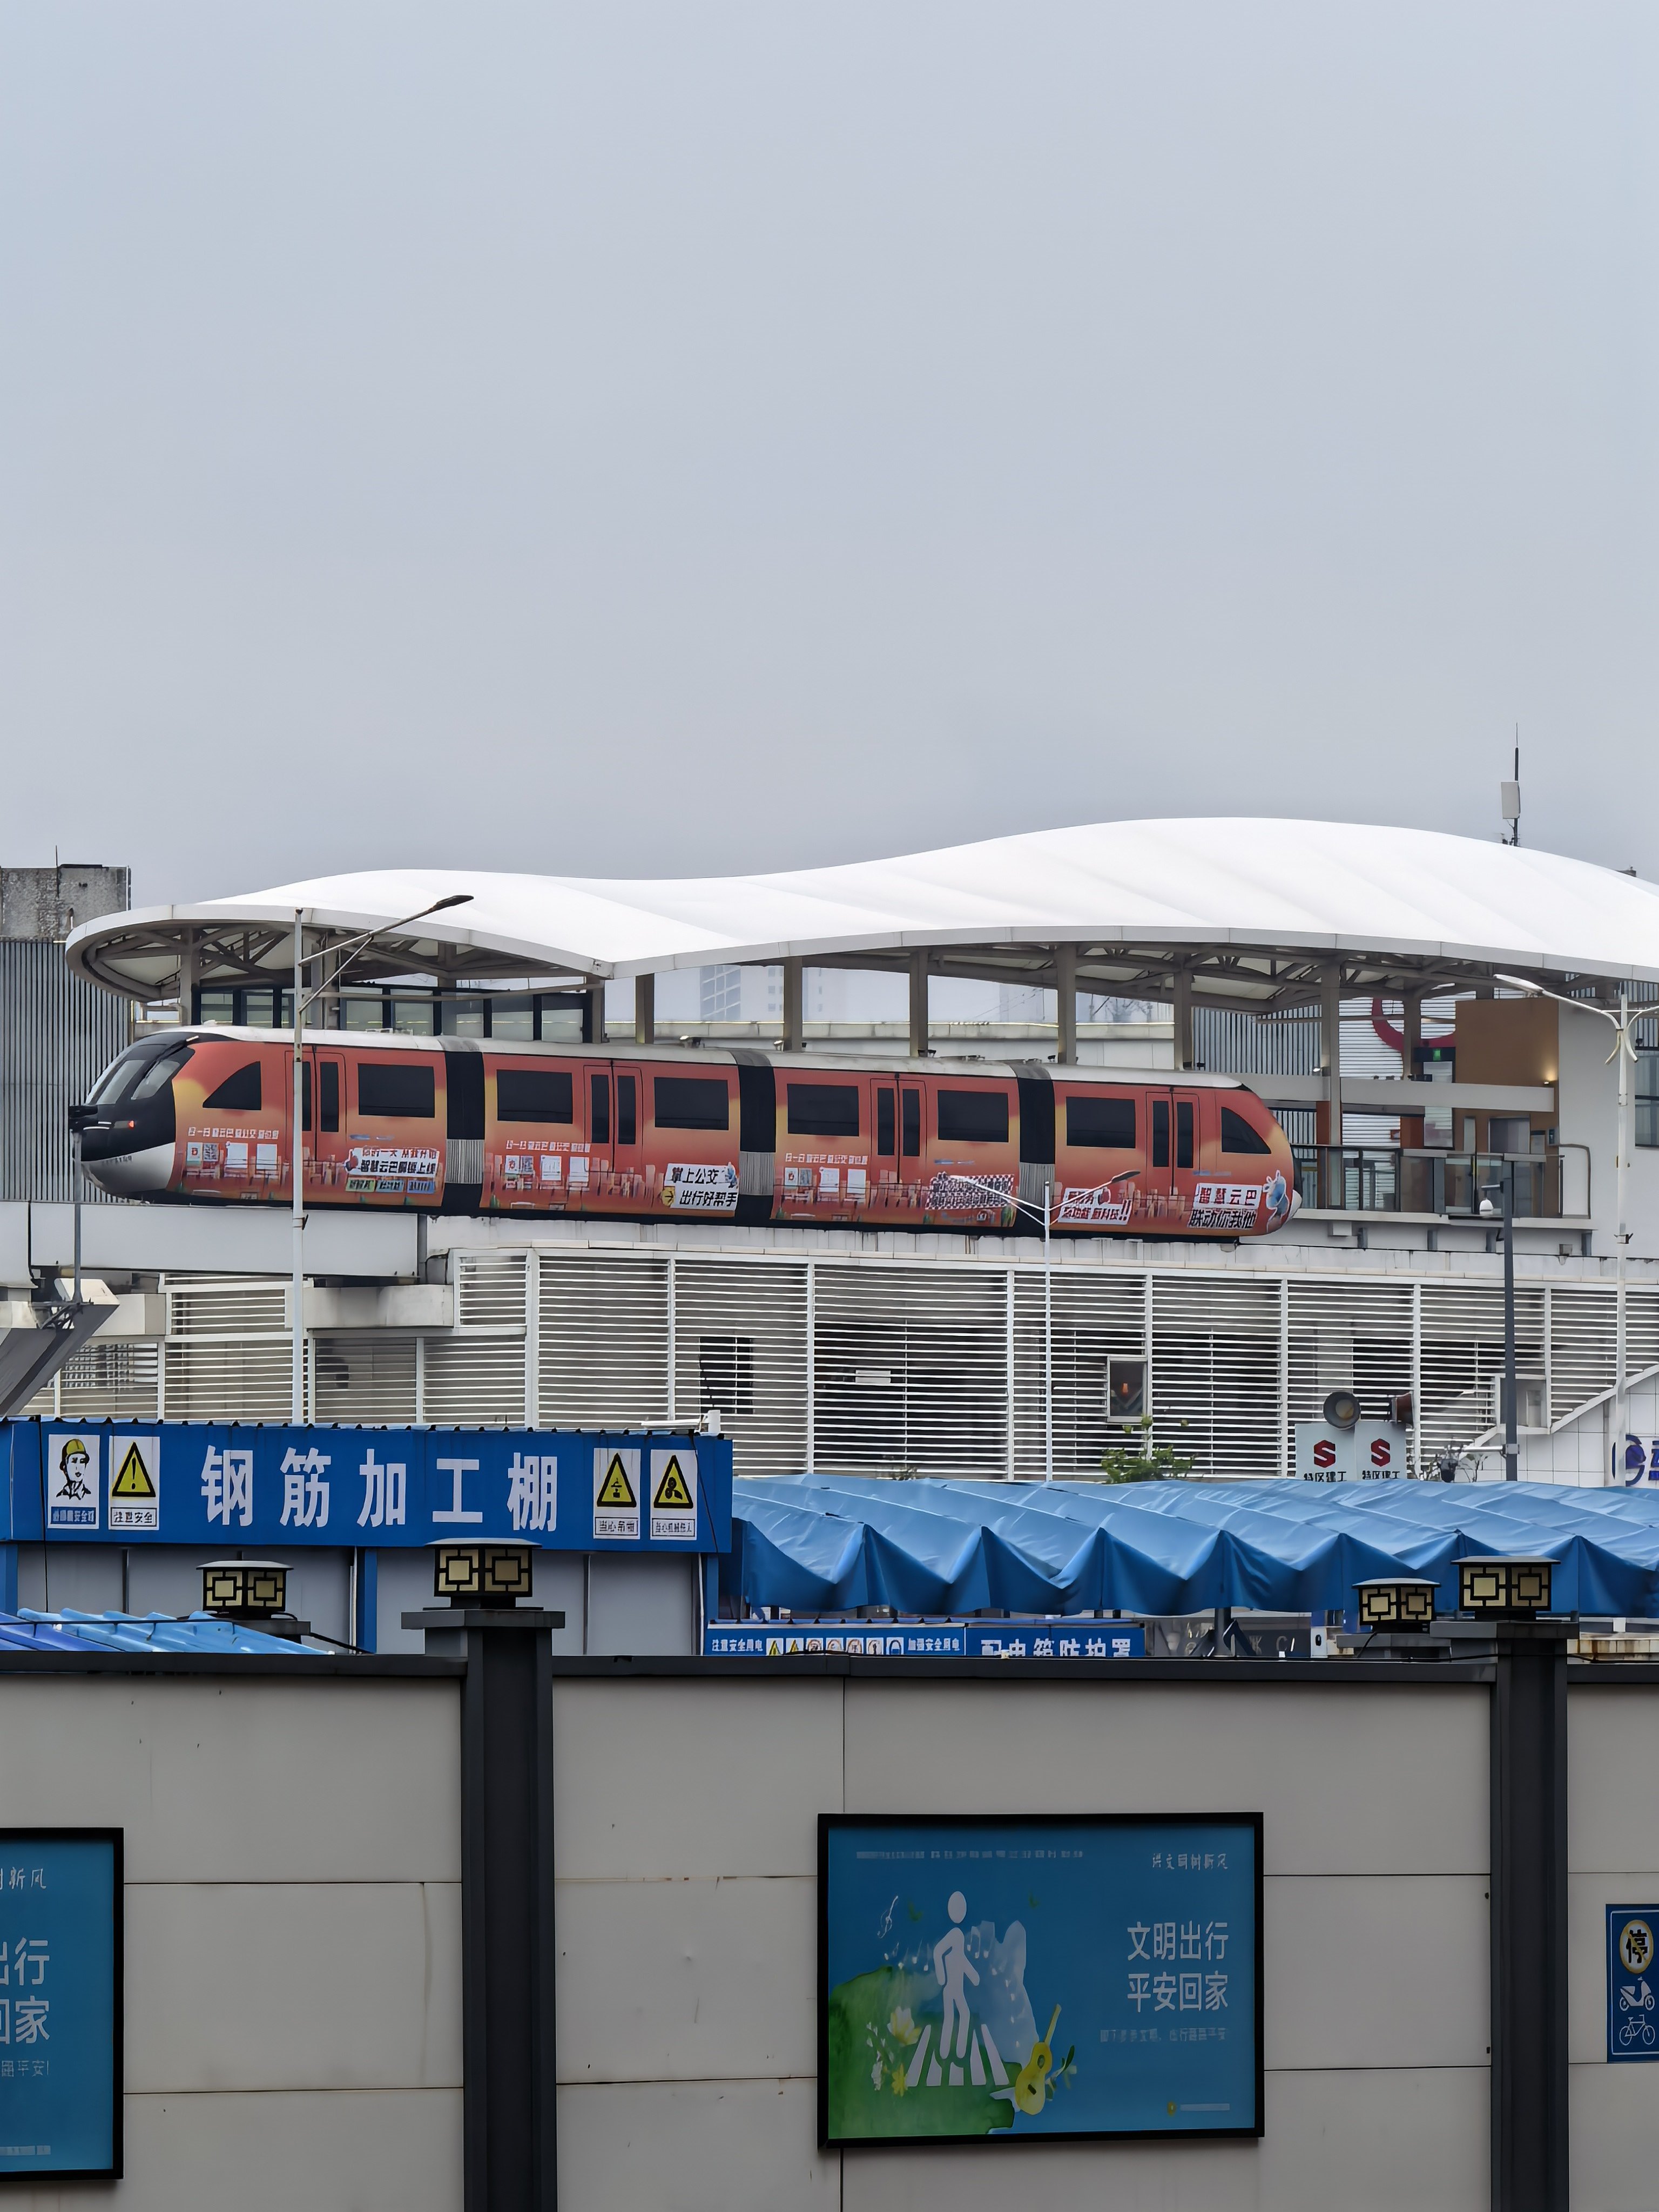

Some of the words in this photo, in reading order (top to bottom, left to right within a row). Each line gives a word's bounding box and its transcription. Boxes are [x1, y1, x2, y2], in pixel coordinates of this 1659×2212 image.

[679, 1190, 738, 1207] 出行好帮手
[1199, 1187, 1257, 1206] 智慧云巴
[200, 1445, 557, 1532] 钢筋加工棚
[0, 1866, 46, 1890] 新风
[1127, 1920, 1229, 1961] 文明出行
[1626, 1928, 1648, 1964] 停
[1127, 1970, 1229, 2013] 平安回家
